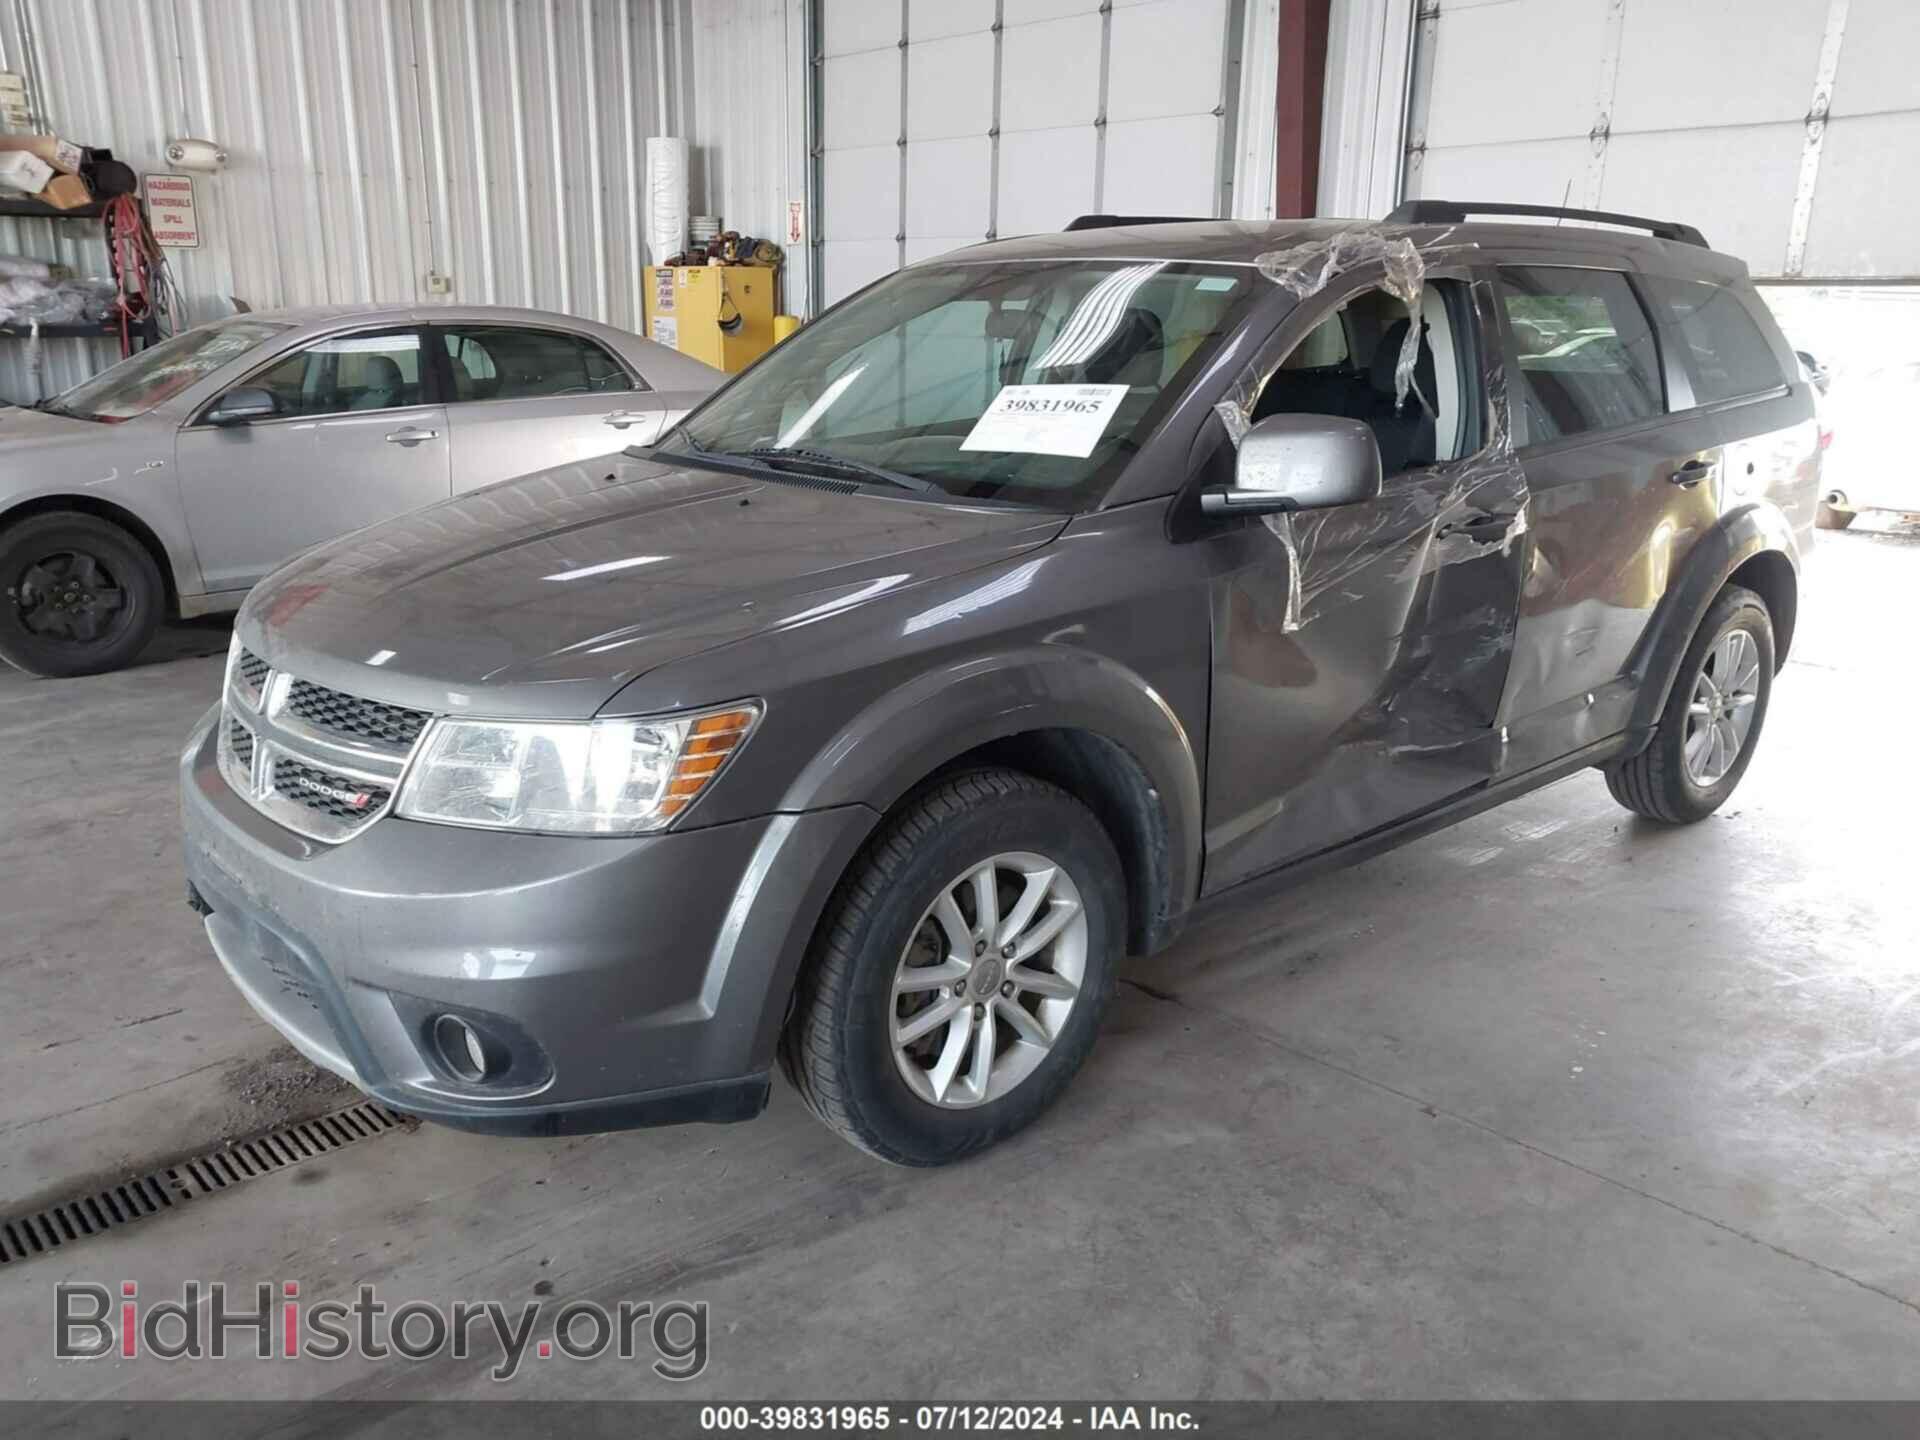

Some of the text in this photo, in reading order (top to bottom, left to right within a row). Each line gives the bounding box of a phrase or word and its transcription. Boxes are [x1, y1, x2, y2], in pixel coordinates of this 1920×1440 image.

[151, 198, 191, 208] MATERIALS
[163, 214, 183, 224] SPILL
[1000, 399, 1103, 414] 39831965
[299, 777, 356, 802] DODGE
